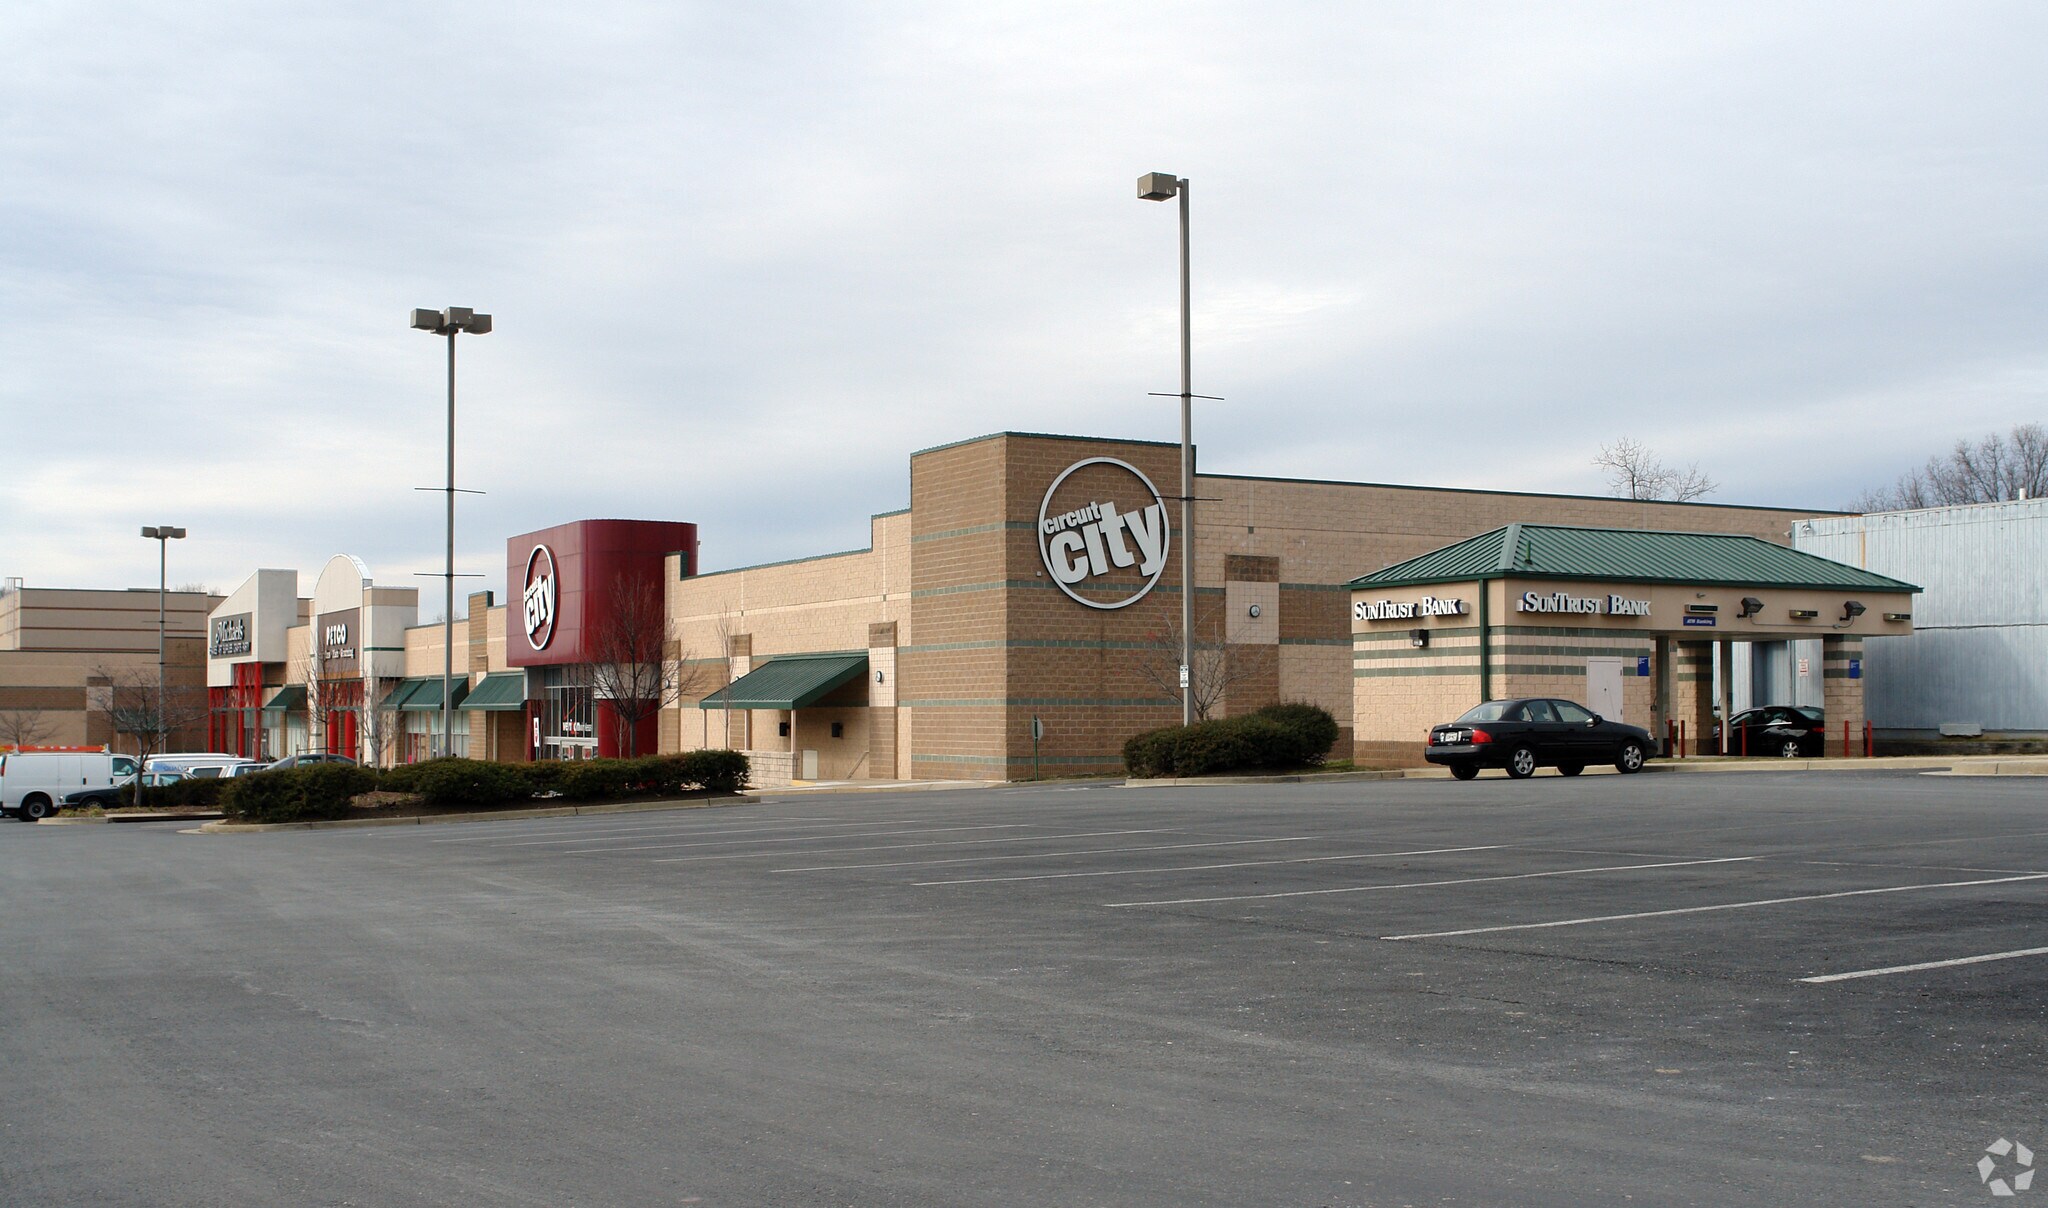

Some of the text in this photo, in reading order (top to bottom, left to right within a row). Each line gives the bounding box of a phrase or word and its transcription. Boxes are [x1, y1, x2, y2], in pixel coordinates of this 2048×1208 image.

[1043, 501, 1101, 534] circuit
[1050, 501, 1162, 583] city
[526, 573, 554, 634] city
[1422, 596, 1459, 616] BANK
[1610, 595, 1651, 616] BANK
[215, 619, 245, 644] Michaels
[326, 623, 348, 646] PETCO
